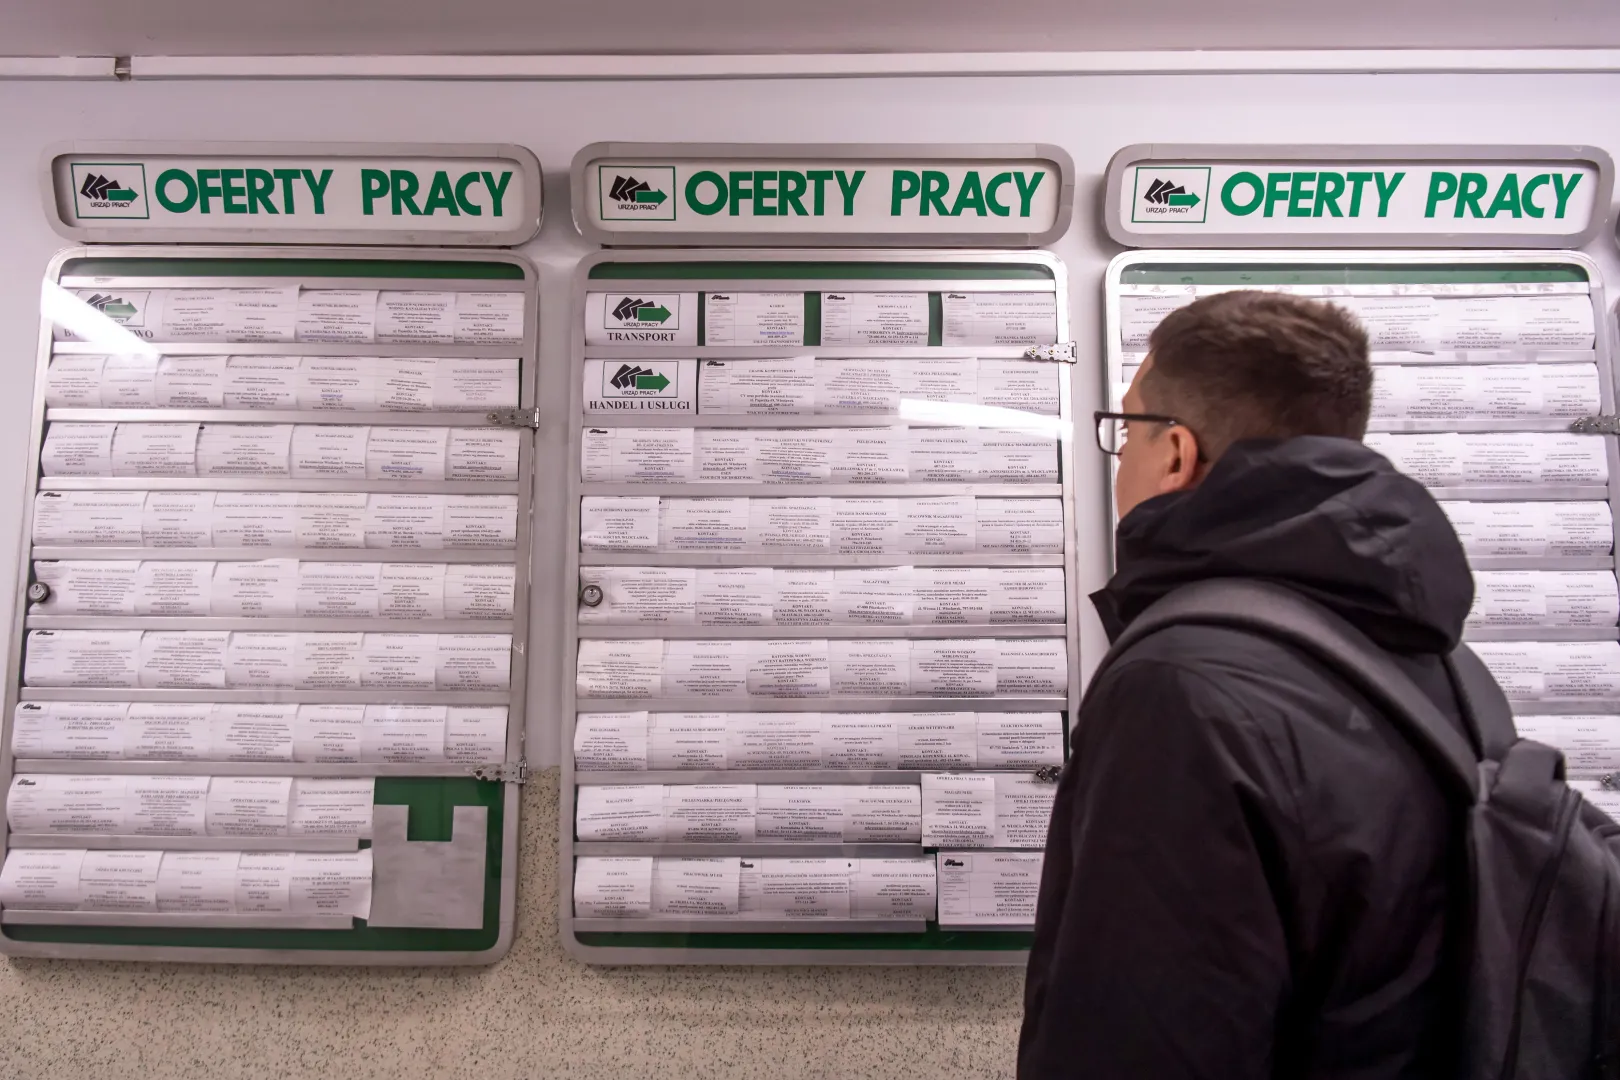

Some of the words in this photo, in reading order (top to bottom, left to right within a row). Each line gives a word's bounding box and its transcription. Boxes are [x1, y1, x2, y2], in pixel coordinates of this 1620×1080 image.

[155, 168, 334, 215] OFERTY
[361, 169, 513, 217] PRACY
[684, 170, 867, 217] OFERTY
[890, 171, 1045, 218] PRACY
[1220, 171, 1406, 219] OFERTY
[1424, 173, 1585, 219] PRACY
[90, 201, 111, 209] URZĄD
[111, 201, 131, 209] PRACY
[617, 204, 638, 212] URZĄD
[639, 203, 658, 211] PRACY
[1146, 207, 1167, 215] URZĄD
[1168, 206, 1189, 214] PRACY
[607, 332, 676, 341] TRANSPORT
[589, 401, 637, 410] HANDEL
[640, 401, 644, 409] I
[648, 400, 690, 409] USŁUGI
